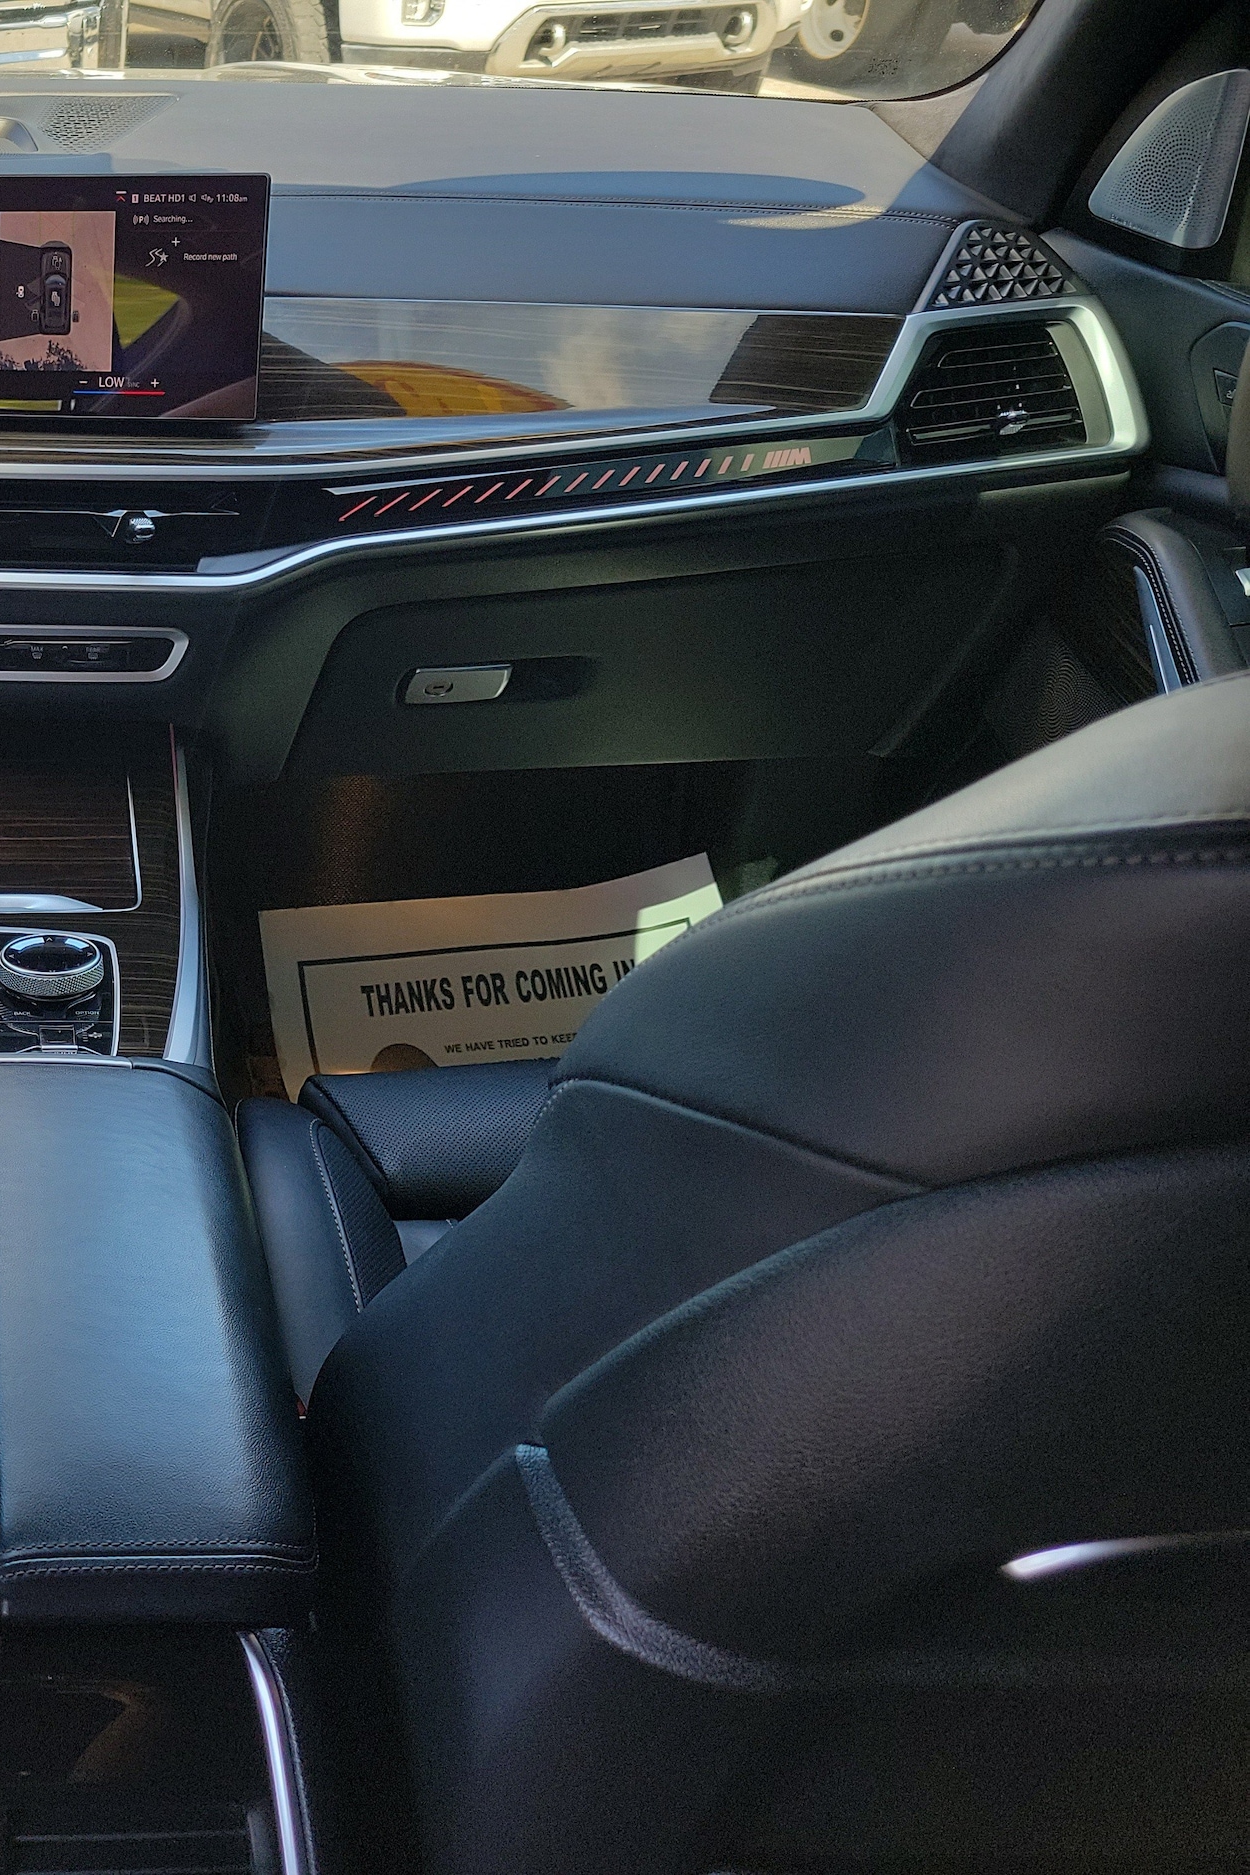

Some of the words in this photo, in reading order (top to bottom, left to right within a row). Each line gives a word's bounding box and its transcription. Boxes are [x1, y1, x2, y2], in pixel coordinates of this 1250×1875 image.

[144, 194, 166, 202] BEAT
[168, 194, 185, 202] HD1
[153, 215, 193, 224] Searching...
[183, 253, 207, 261] Record
[222, 253, 238, 262] path
[98, 377, 125, 388] LOW
[360, 977, 455, 1017] THANKS
[461, 973, 510, 1008] FOR
[516, 963, 608, 1003] COMING
[444, 1044, 462, 1053] WE
[465, 1041, 495, 1052] HAVE
[497, 1037, 529, 1049] TRIED
[532, 1036, 548, 1045] TO
